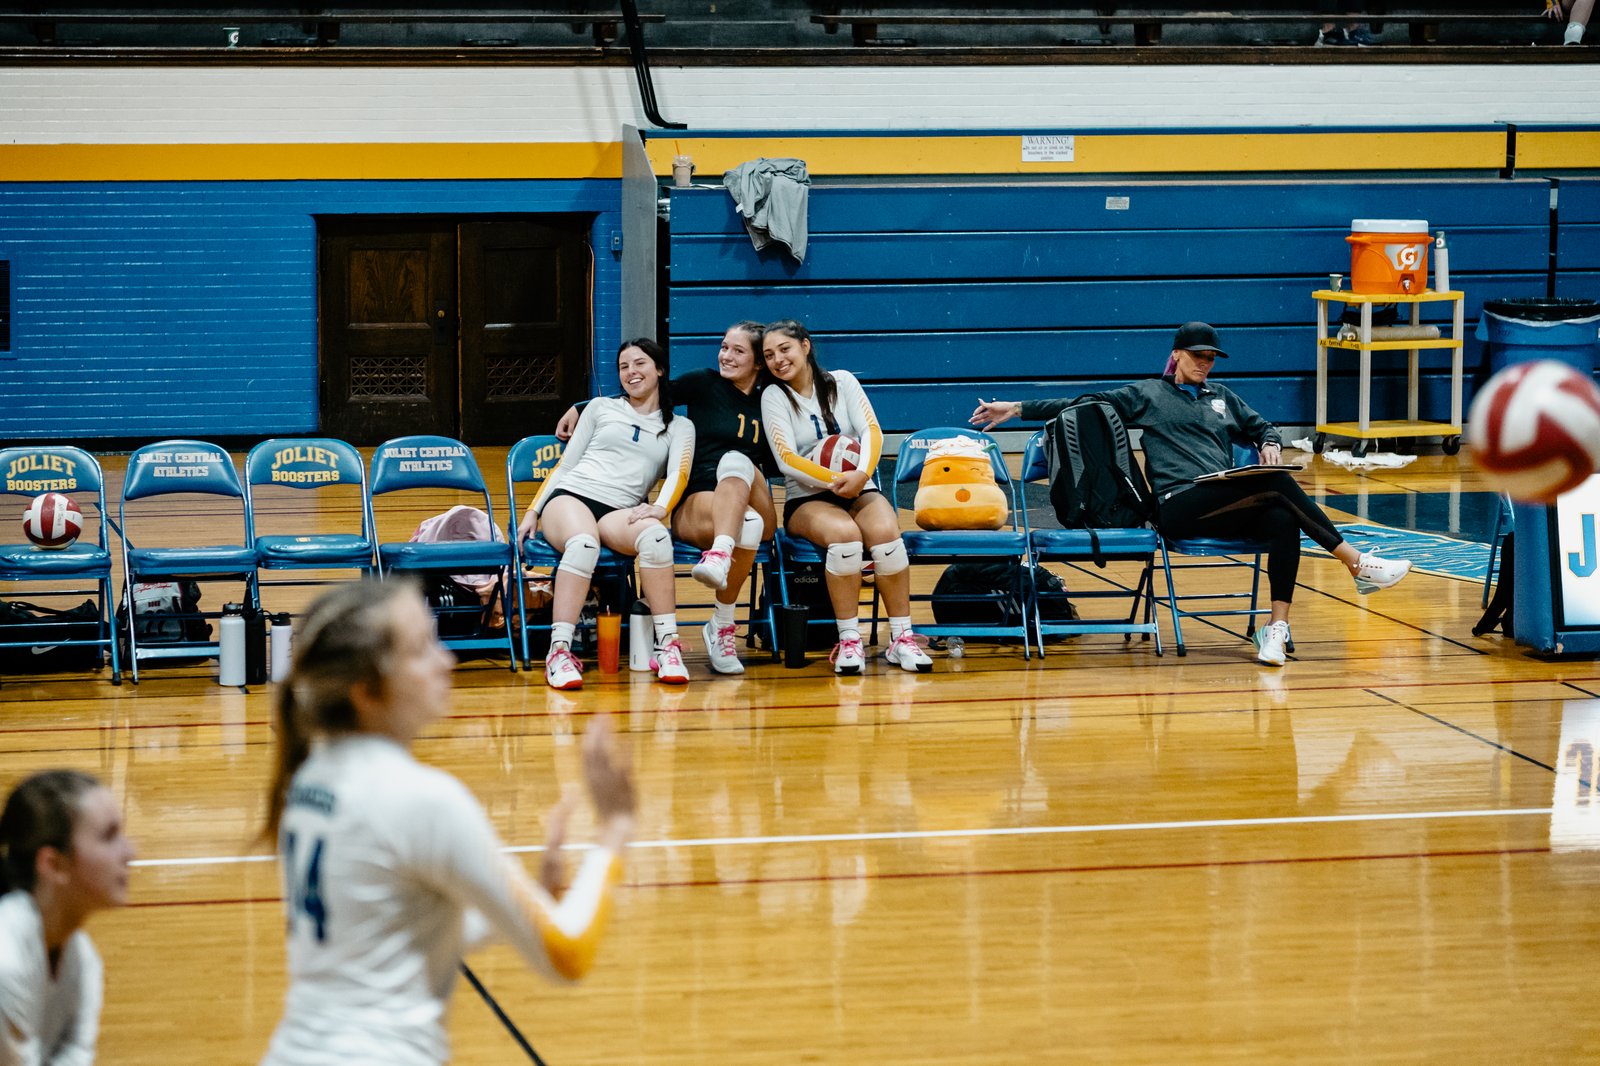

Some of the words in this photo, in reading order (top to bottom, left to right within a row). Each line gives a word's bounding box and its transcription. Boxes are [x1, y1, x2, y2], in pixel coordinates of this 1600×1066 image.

[1028, 136, 1069, 144] WARNING!
[1401, 247, 1415, 265] G
[632, 424, 641, 442] 1
[737, 413, 760, 443] 11
[136, 453, 173, 463] JOLIET
[175, 452, 223, 463] CENTRAL
[271, 446, 339, 469] JOLIET
[383, 447, 418, 458] JOLIET
[419, 446, 466, 457] CENTRAL
[6, 454, 76, 479] JOLIET
[153, 466, 209, 477] ATHLETICS
[399, 460, 453, 471] ATHLETICS
[271, 470, 339, 482] BOOSTERS
[7, 478, 77, 491] BOOSTERS
